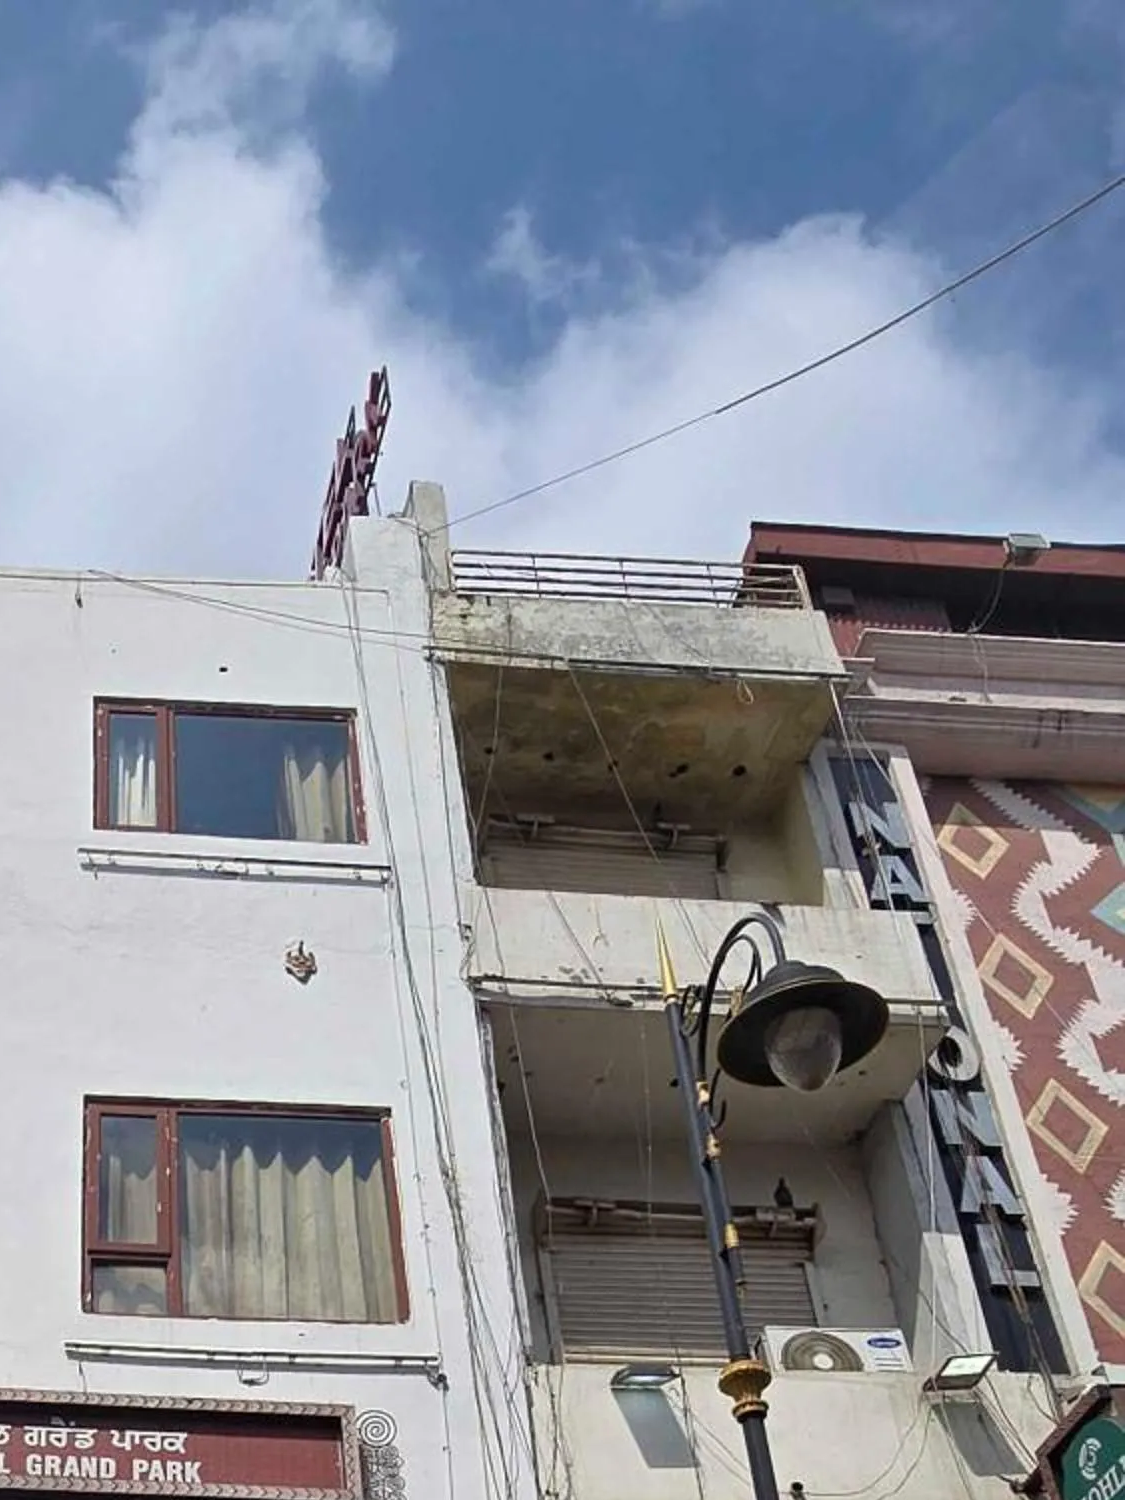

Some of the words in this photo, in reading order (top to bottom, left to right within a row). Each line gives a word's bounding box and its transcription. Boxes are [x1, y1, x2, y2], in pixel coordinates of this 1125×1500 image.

[110, 1429, 188, 1454] ਪਾਰਕ
[26, 1453, 117, 1480] GRAND
[132, 1459, 202, 1485] PARK
